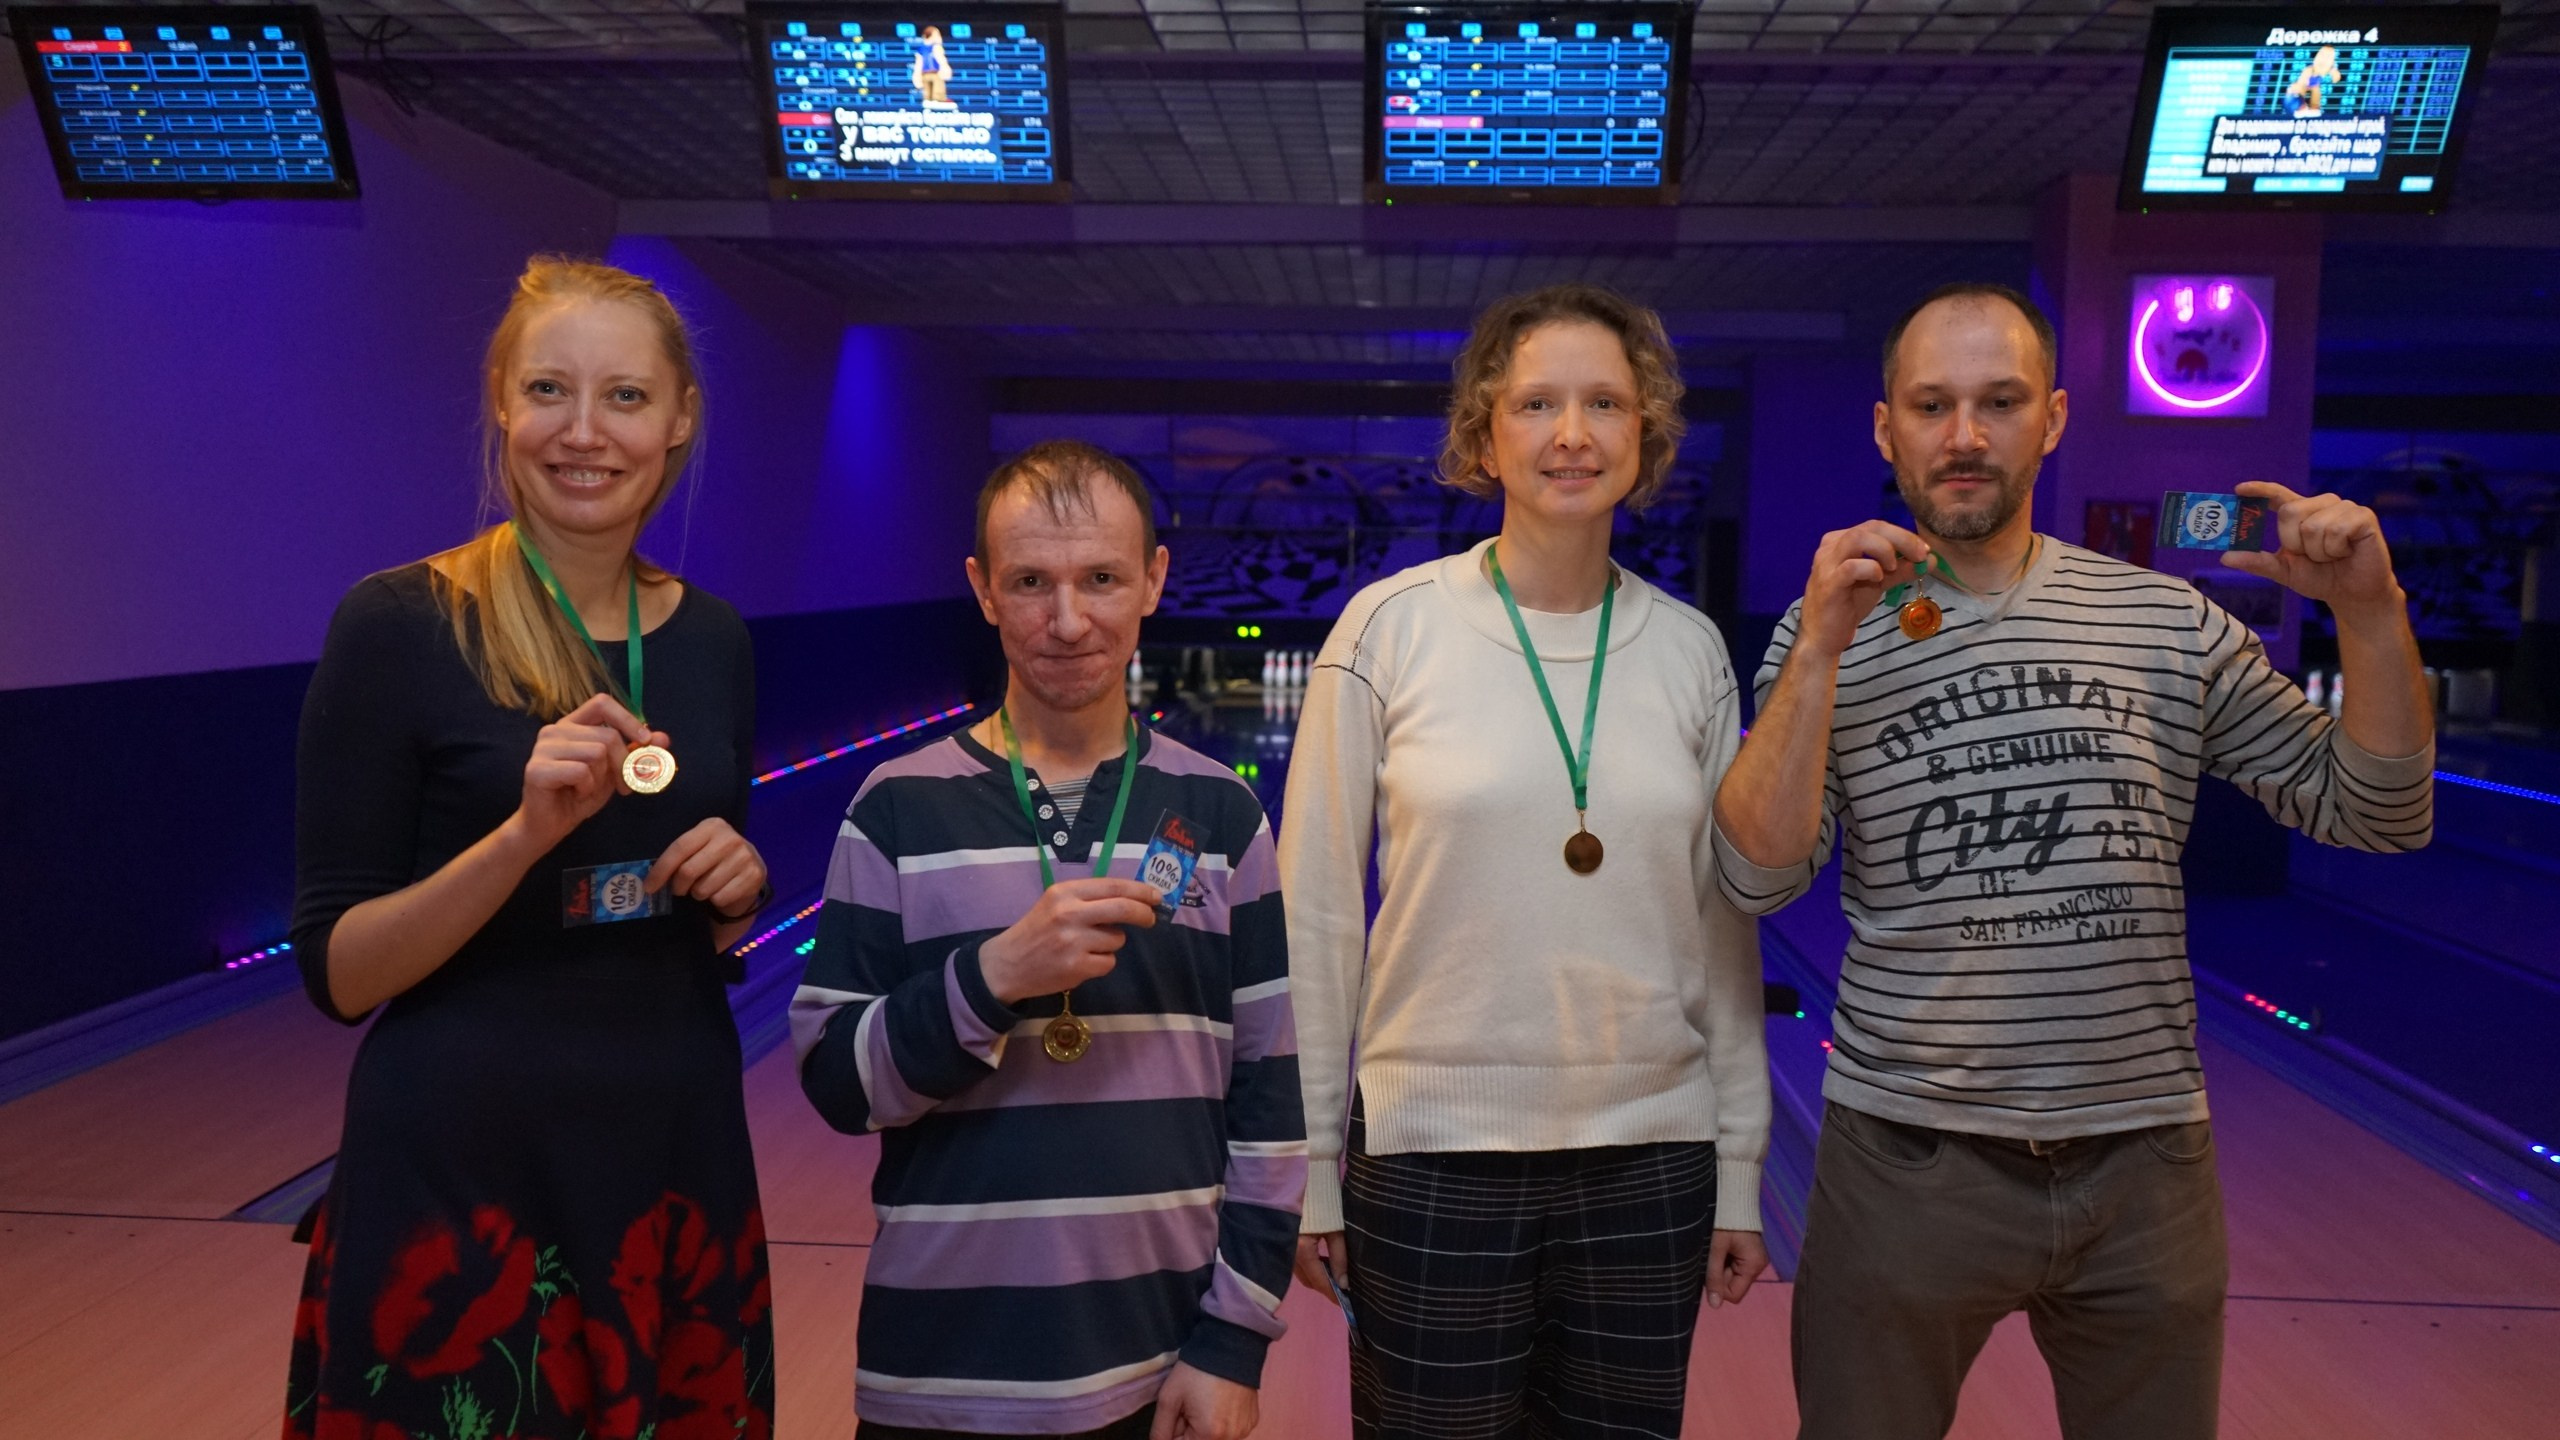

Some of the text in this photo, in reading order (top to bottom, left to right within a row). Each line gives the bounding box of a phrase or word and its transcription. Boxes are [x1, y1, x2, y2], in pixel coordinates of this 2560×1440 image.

[2266, 27, 2379, 46] Дорожка 4
[1967, 732, 2115, 775] GENUINE
[1905, 791, 2074, 892] City
[1148, 873, 1173, 891] СКИДКА
[1959, 886, 2133, 942] SAN FRANCISCO
